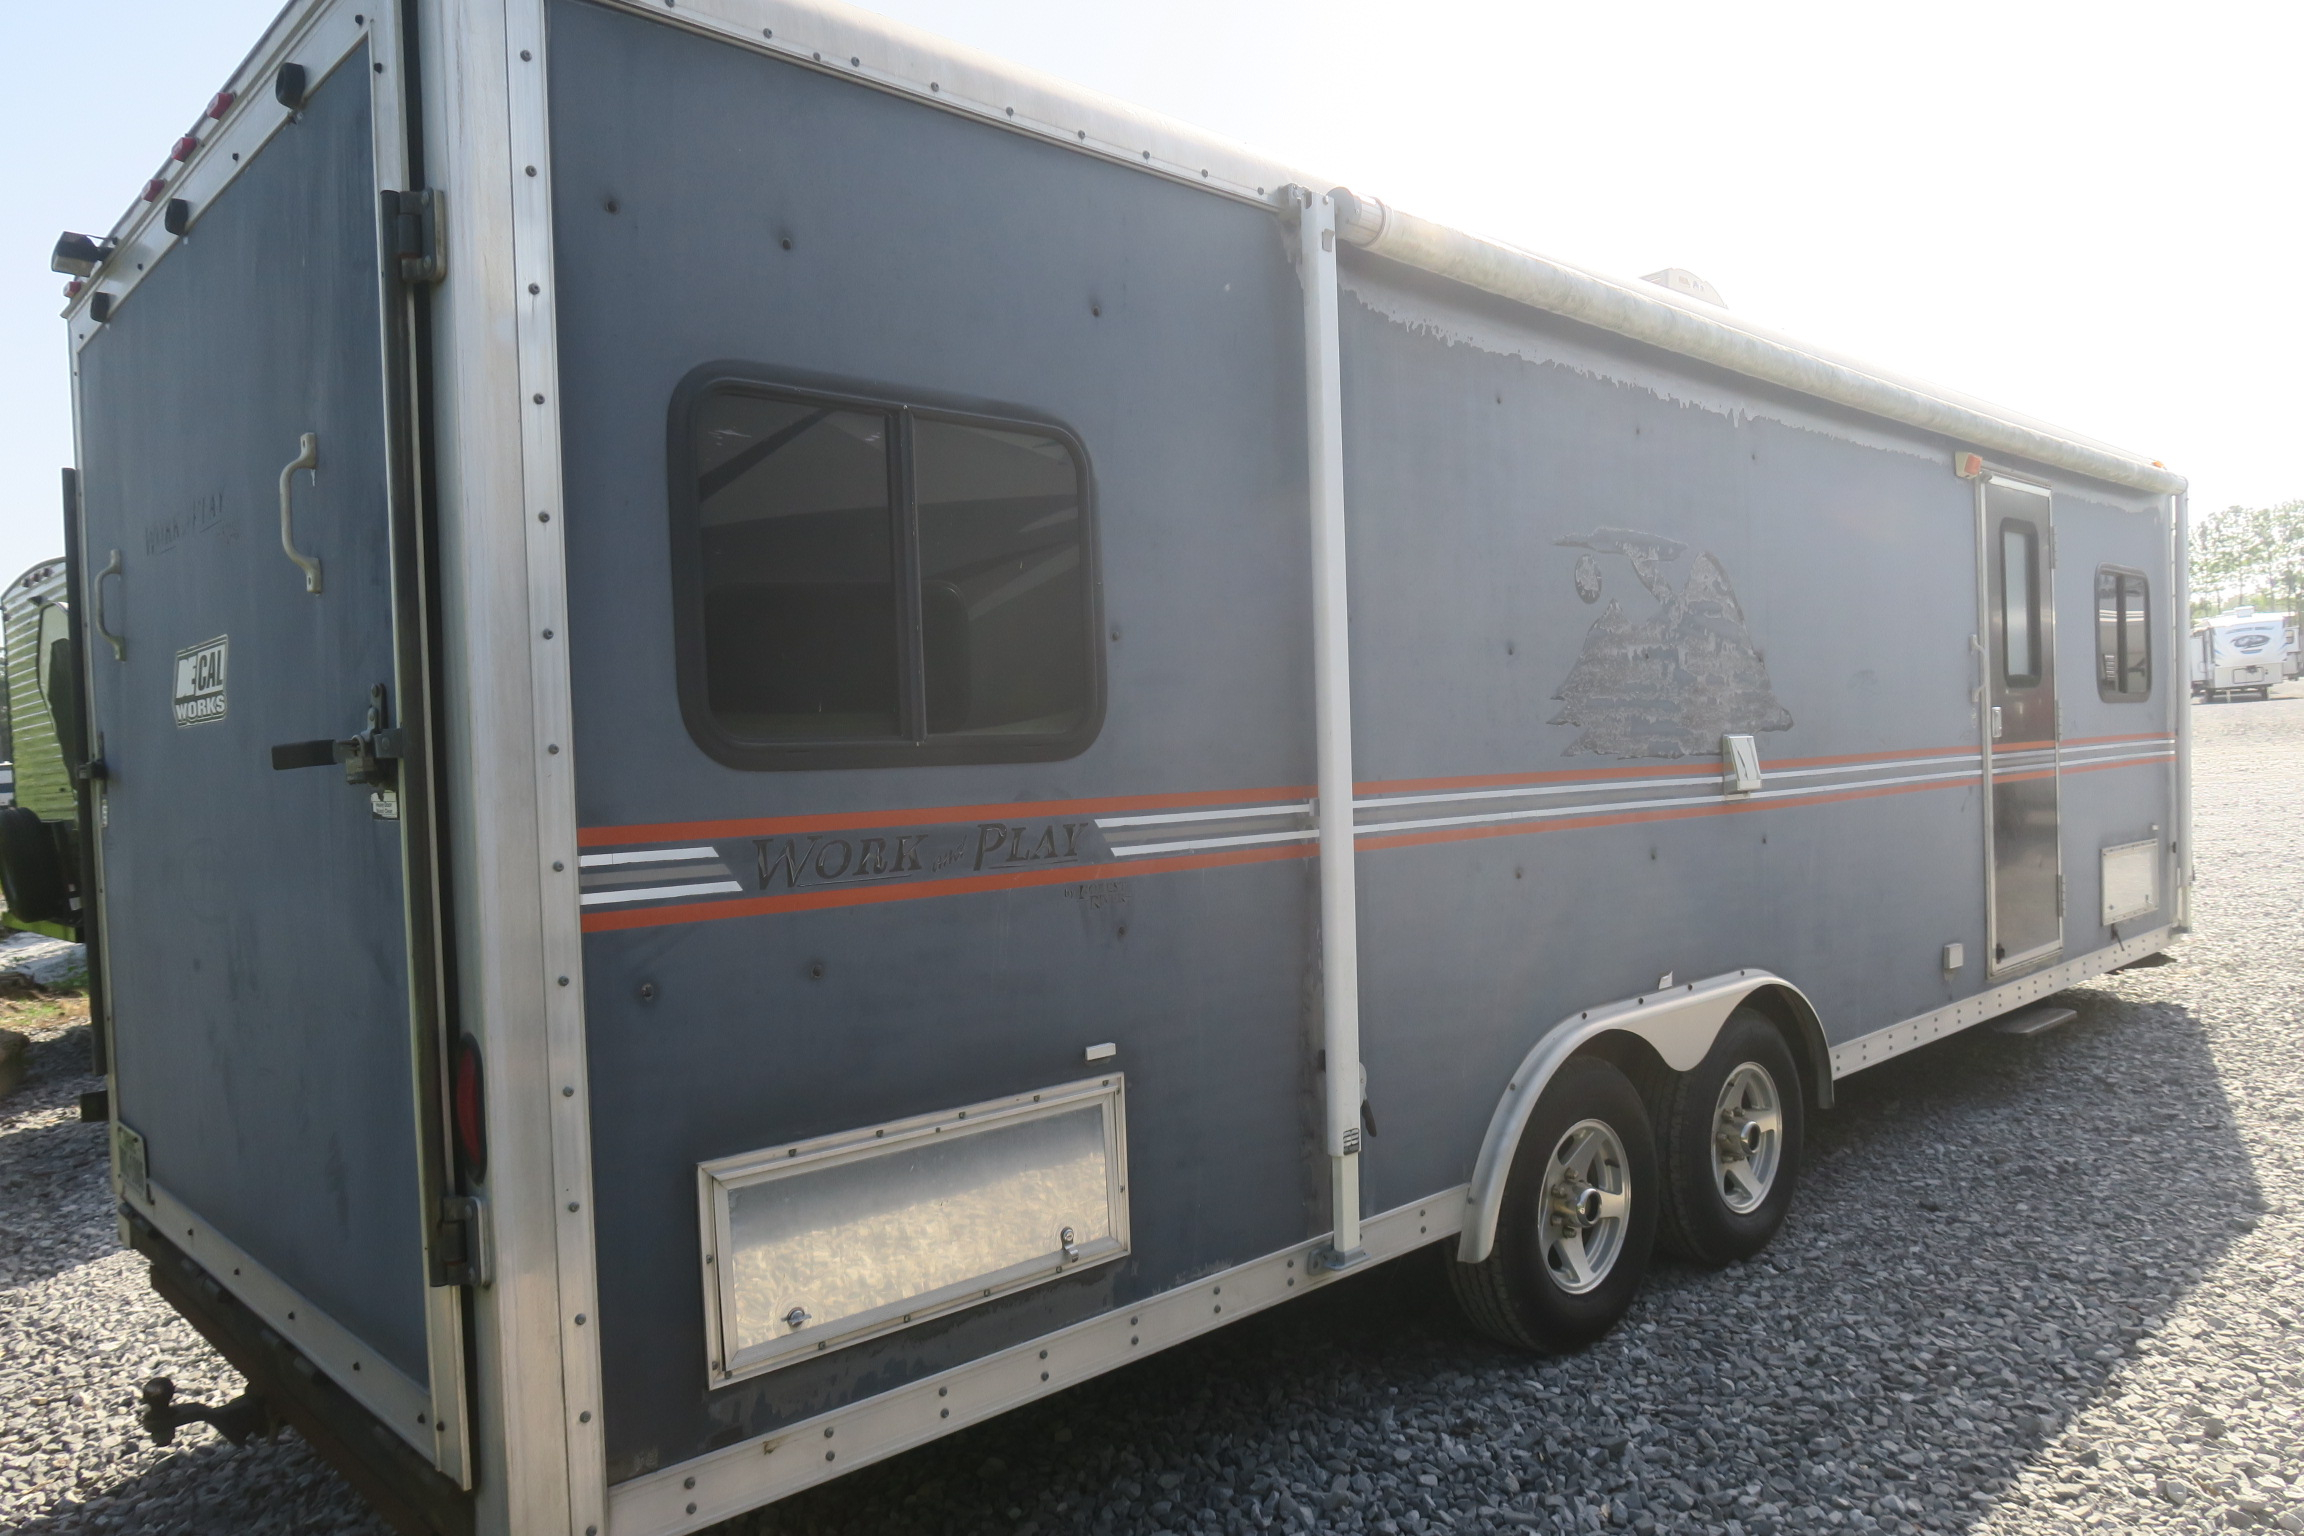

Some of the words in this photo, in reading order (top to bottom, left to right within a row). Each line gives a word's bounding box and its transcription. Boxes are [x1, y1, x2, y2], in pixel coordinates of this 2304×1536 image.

[175, 695, 226, 720] WORKS
[752, 834, 929, 890] WORK
[973, 822, 1089, 871] PLAY
